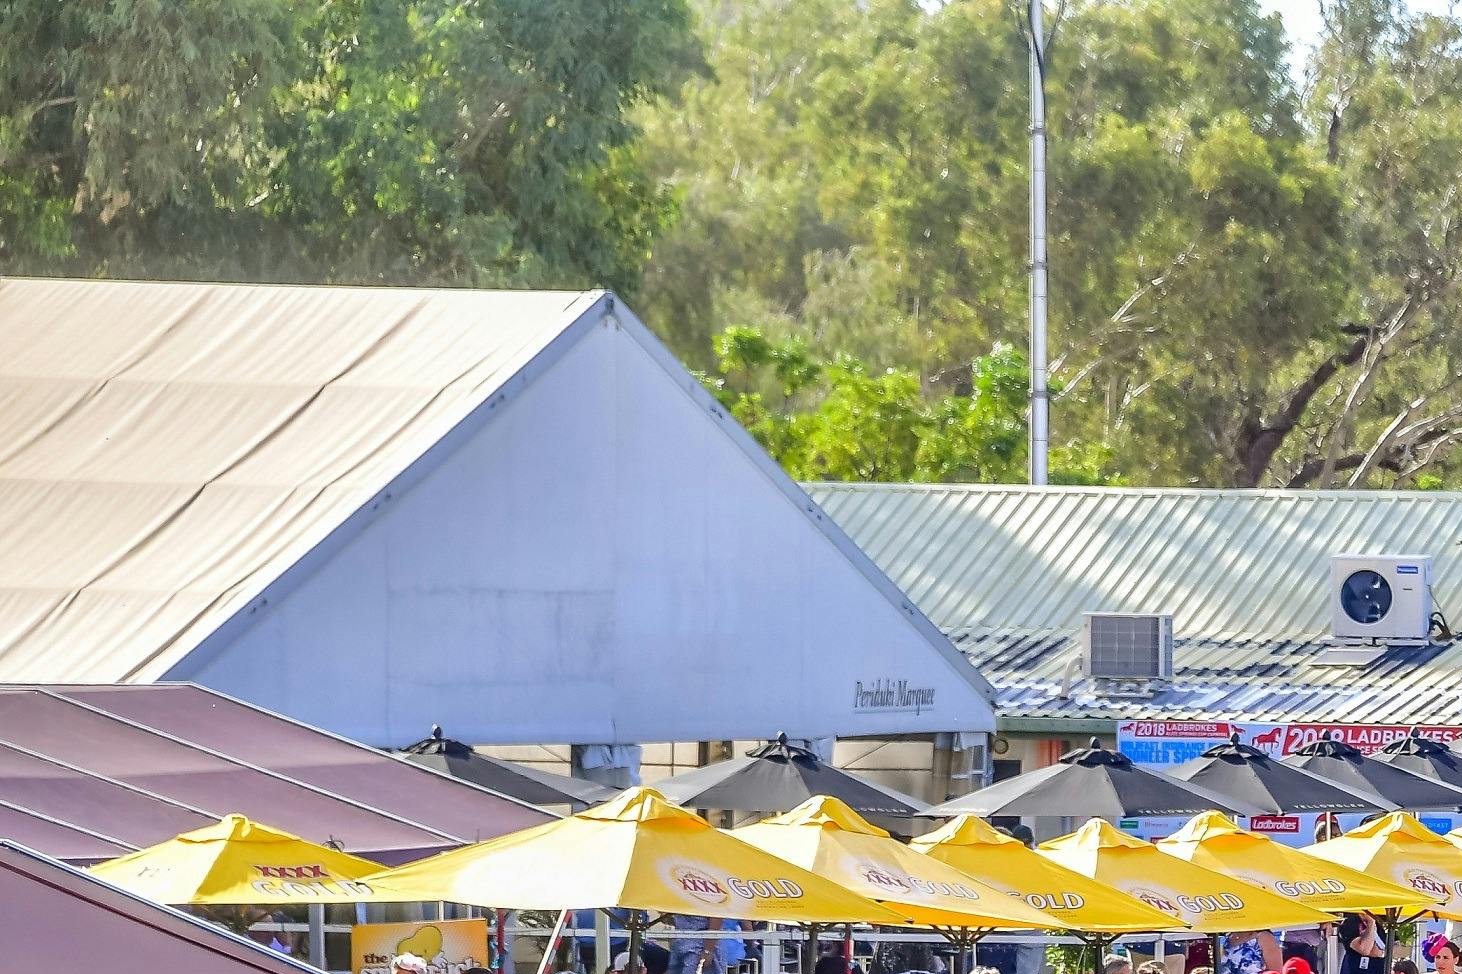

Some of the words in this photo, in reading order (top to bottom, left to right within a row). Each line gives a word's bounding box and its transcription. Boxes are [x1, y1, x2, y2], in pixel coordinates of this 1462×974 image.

[896, 680, 935, 716] Marquee
[1138, 724, 1166, 735] 2018
[1166, 724, 1217, 732] LADBROKES
[1252, 819, 1297, 830] Ladbrokes
[677, 878, 729, 895] XXXX
[726, 876, 804, 899] GOLD
[907, 876, 980, 900] GOLD
[1274, 878, 1346, 897] GOLD
[1409, 878, 1452, 896] XXXX
[1175, 892, 1245, 914] GOLD
